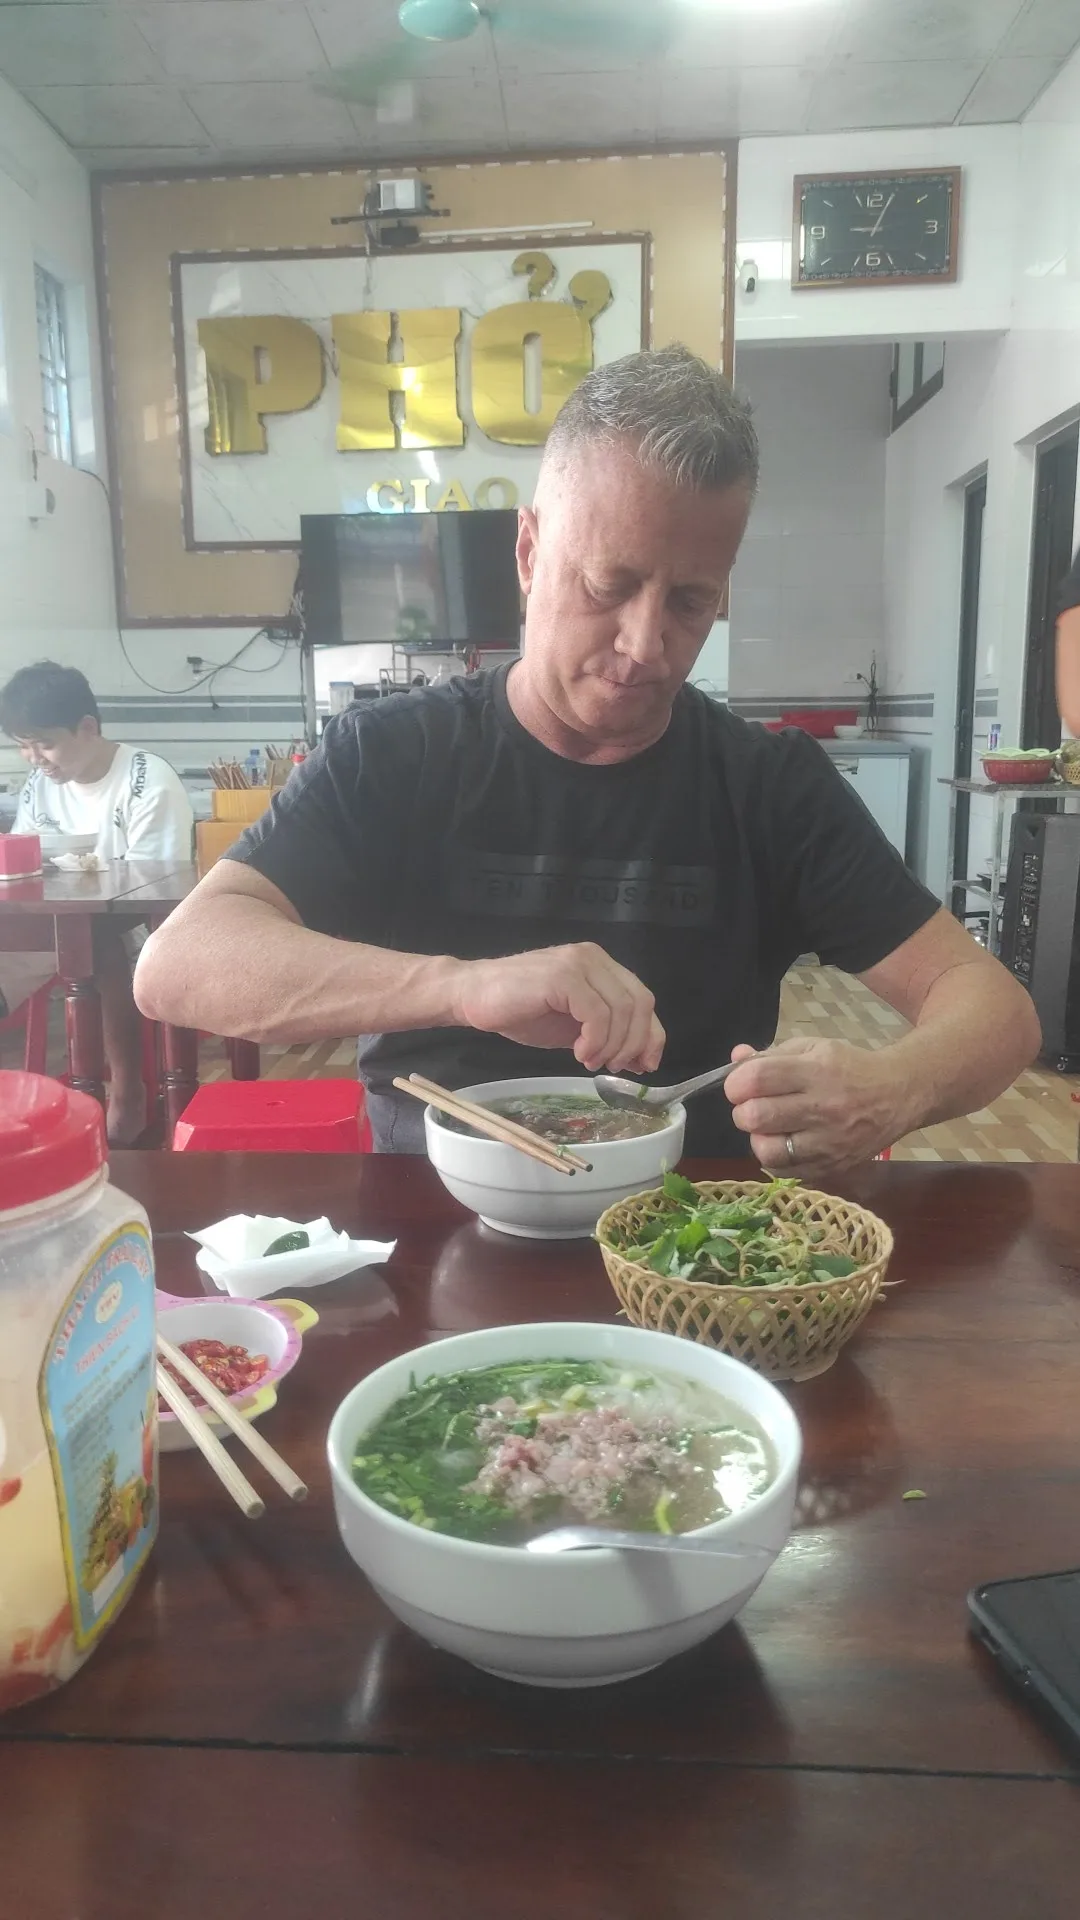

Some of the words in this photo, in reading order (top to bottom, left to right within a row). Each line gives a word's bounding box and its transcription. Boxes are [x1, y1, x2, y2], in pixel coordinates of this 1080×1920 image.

[866, 193, 883, 208] 12
[811, 226, 825, 239] 9
[925, 220, 938, 234] 3
[866, 252, 880, 266] 6
[197, 252, 613, 456] PHỞ
[366, 476, 519, 514] GIAO
[542, 880, 699, 911] TOUSD
